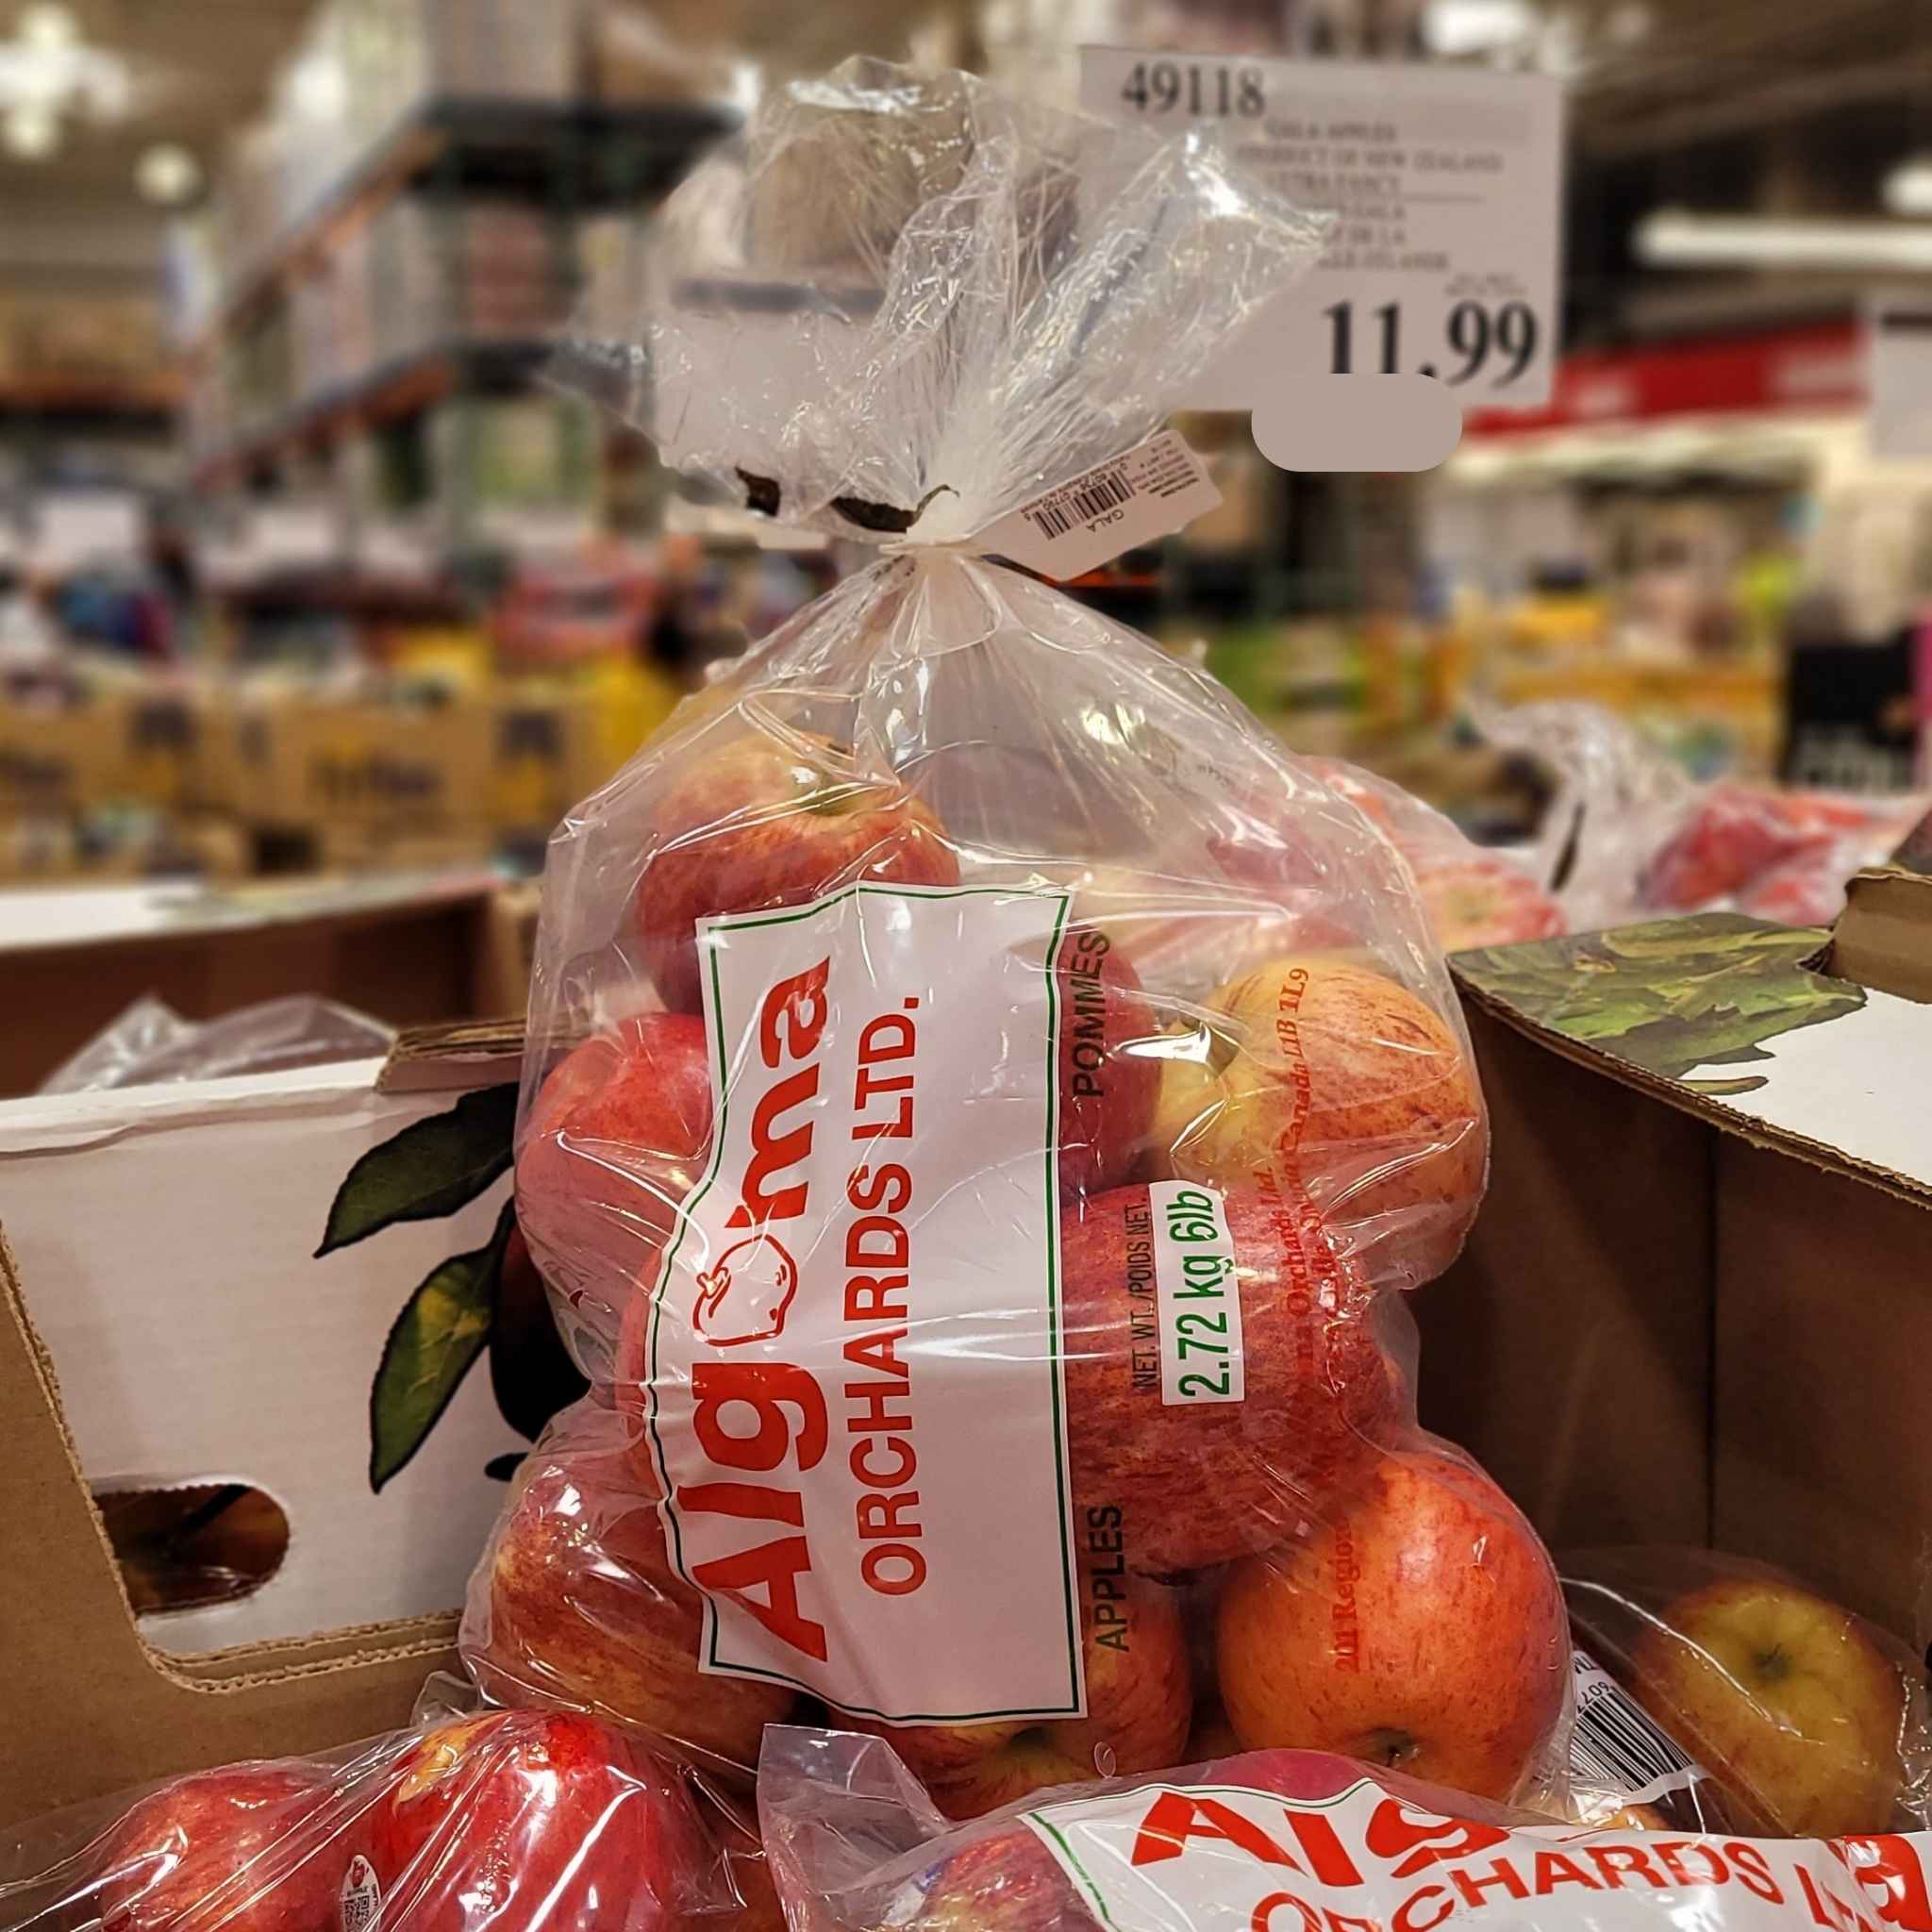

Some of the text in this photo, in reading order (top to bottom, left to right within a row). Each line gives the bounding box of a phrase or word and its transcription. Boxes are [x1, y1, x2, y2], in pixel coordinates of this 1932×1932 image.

[1122, 62, 1266, 117] 49118
[1323, 300, 1539, 389] 11.99
[1086, 508, 1124, 533] GALA
[1072, 931, 1110, 1097] POMMES
[1280, 1062, 1310, 1154] Canada
[1124, 1197, 1151, 1235] NET.
[843, 995, 927, 1596] ORCHARDS LTD.
[1166, 1191, 1234, 1397] 2.72 kg 6lb
[1133, 1346, 1158, 1389] NET.
[1086, 1505, 1130, 1653] APPLES
